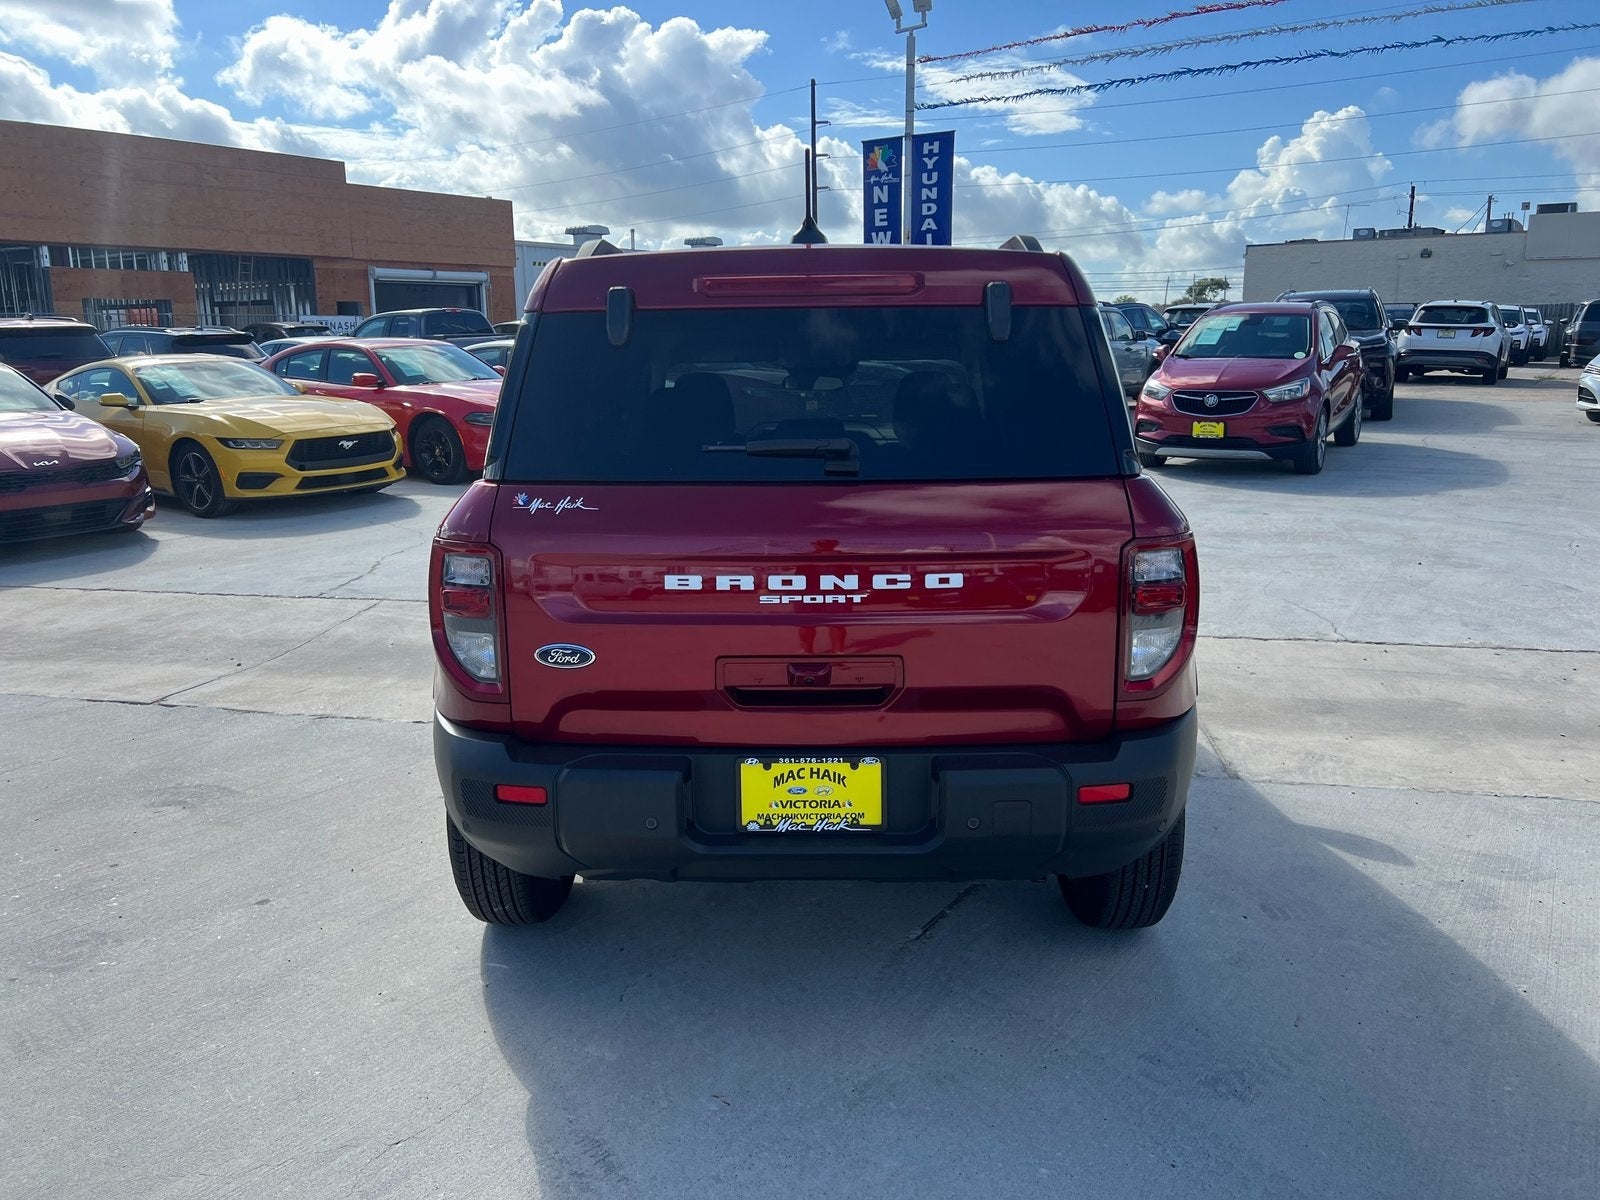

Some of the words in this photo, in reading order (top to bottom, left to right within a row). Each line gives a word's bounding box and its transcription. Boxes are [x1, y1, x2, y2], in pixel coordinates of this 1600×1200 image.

[921, 141, 940, 245] HYUNDAI
[872, 185, 892, 244] NEW
[529, 497, 554, 514] Mac
[554, 496, 586, 514] Haik
[664, 573, 964, 591] BRONCO
[759, 594, 866, 604] SPORT
[547, 648, 580, 664] Ford
[773, 767, 805, 789] MAC
[810, 767, 847, 788] HAIK
[780, 800, 842, 809] VICTORIA
[774, 817, 808, 833] Mac
[811, 817, 849, 832] Haik
